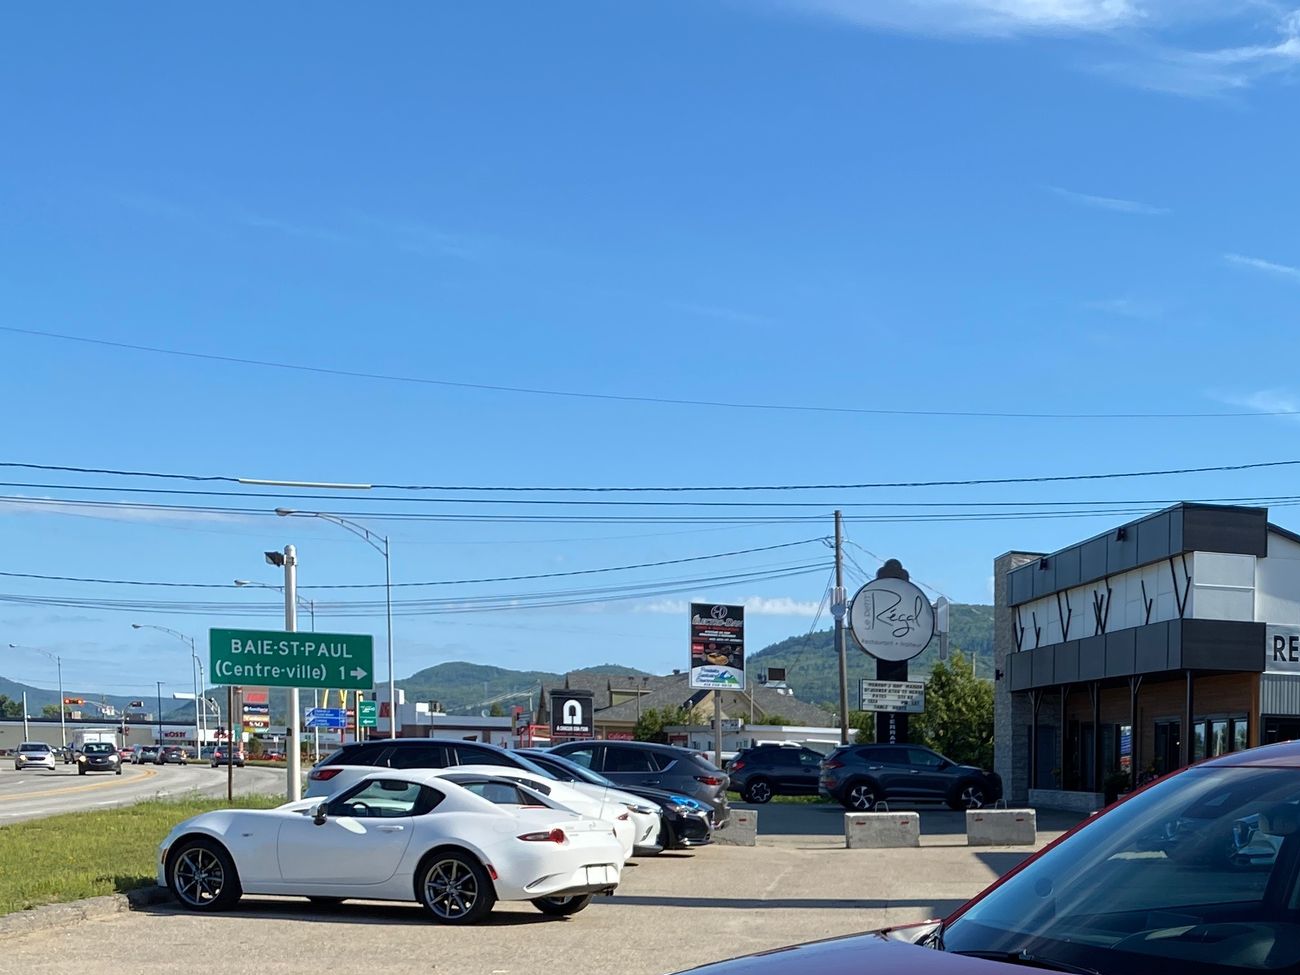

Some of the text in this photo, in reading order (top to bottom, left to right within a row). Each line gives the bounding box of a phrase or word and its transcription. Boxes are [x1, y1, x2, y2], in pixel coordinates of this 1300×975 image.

[231, 638, 353, 658] BAIE-ST-PAUL
[215, 659, 346, 681] (Centre-ville) 1
